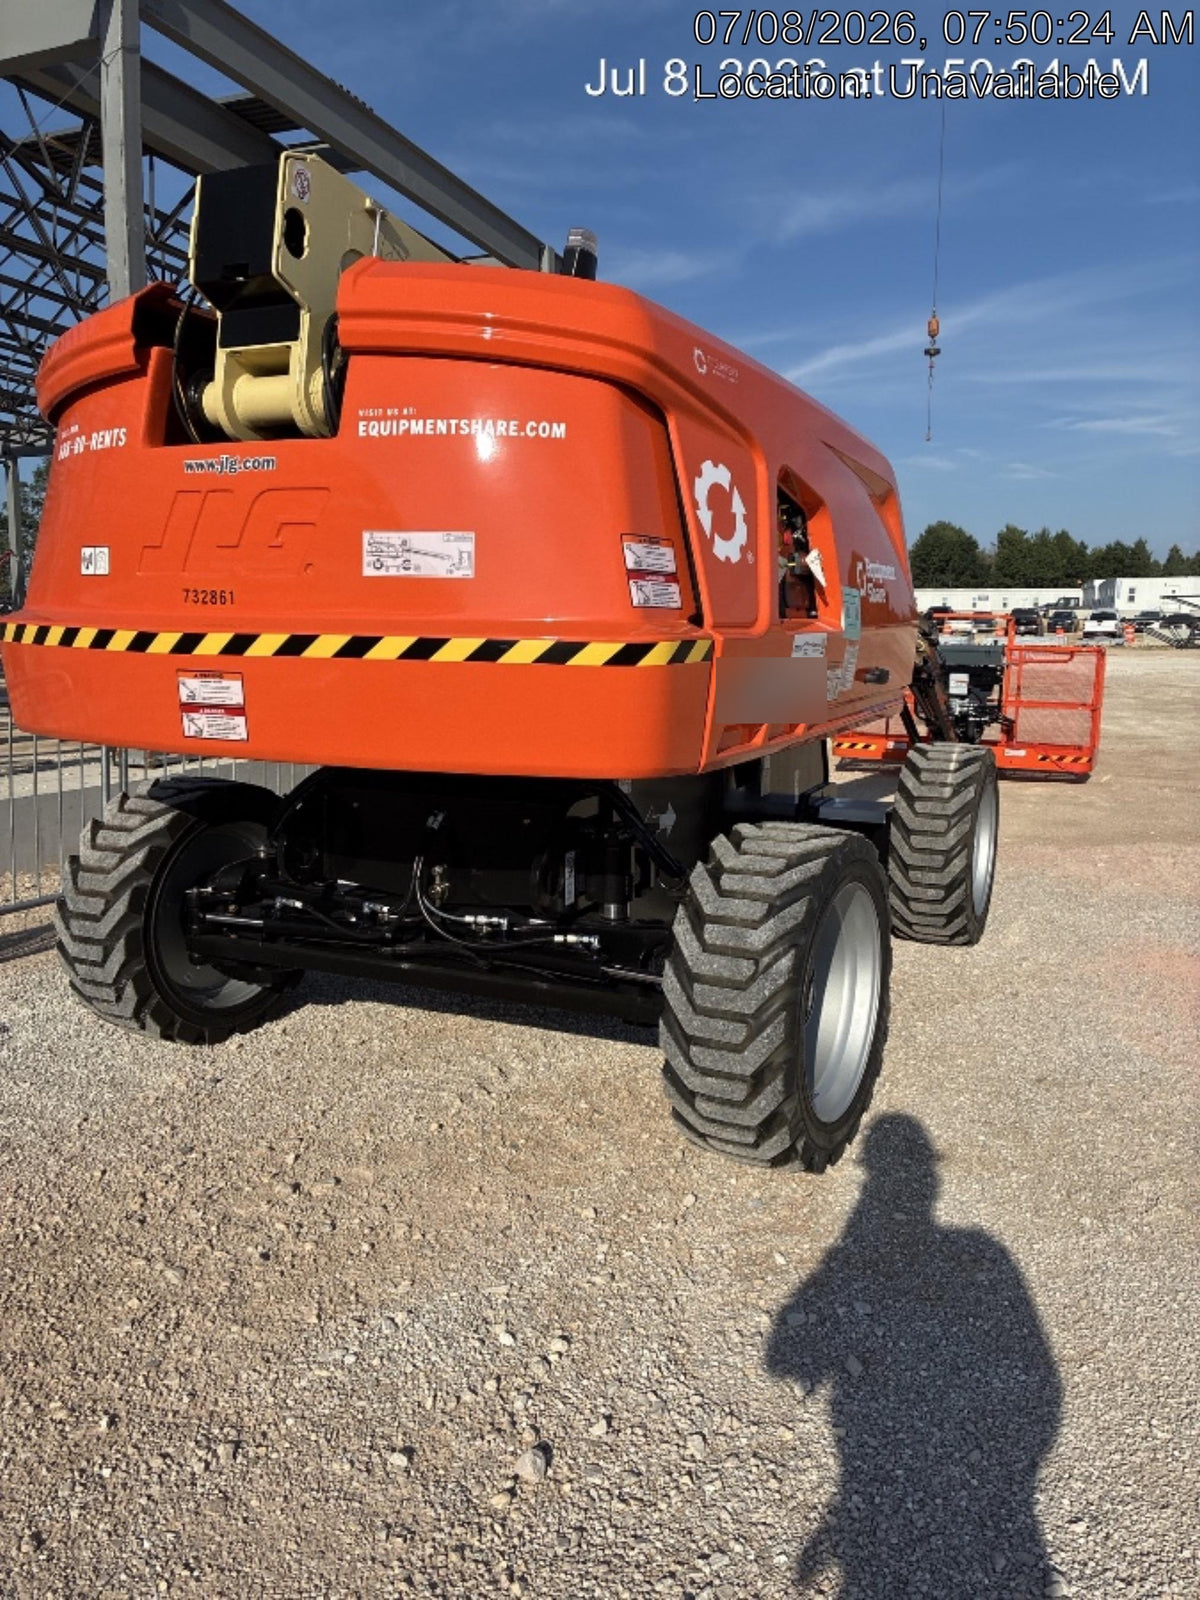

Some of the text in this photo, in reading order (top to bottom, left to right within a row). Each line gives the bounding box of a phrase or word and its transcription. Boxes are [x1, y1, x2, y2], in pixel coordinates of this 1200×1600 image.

[358, 418, 567, 439] EQUIPMENTSHARE.COM
[183, 454, 277, 475] www.jlg.com
[182, 588, 236, 606] 732861
